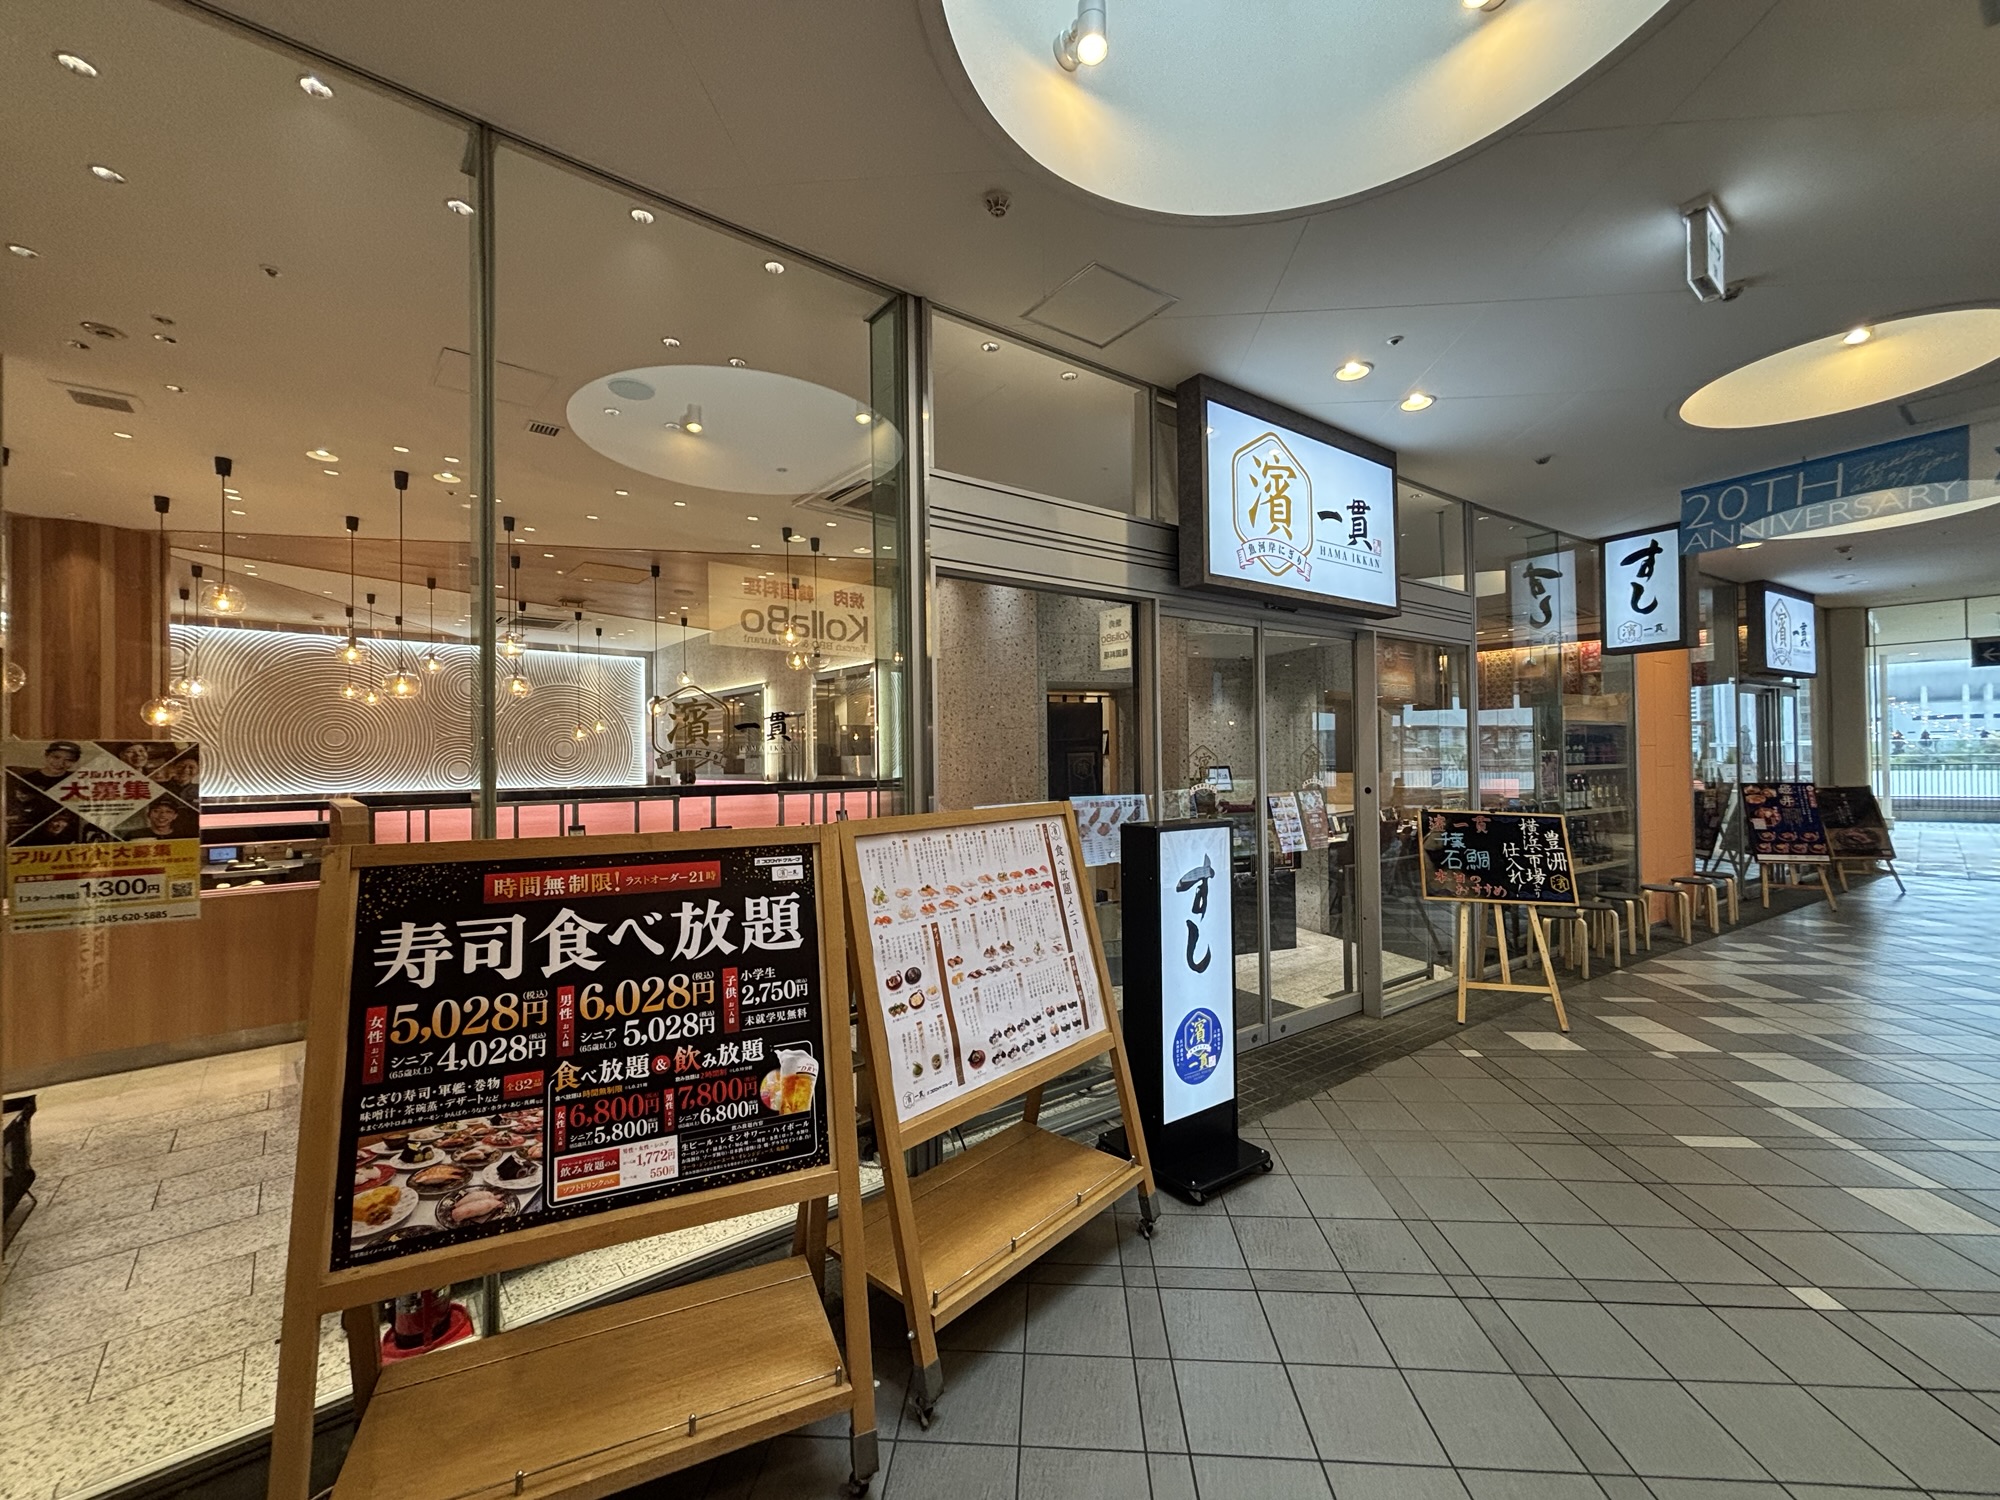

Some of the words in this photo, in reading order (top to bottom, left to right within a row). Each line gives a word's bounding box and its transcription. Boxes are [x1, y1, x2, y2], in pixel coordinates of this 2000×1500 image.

[1248, 454, 1297, 541] 濱
[1686, 462, 1844, 530] 20TH
[1683, 479, 1961, 553] ANNIVERSARY
[1248, 541, 1302, 566] 魚河岸にぎり
[1320, 545, 1348, 562] HAMA
[1352, 553, 1380, 569] IKKAN
[1619, 538, 1664, 615] すし
[666, 697, 716, 746] 濱
[77, 770, 135, 779] アルバイト
[60, 780, 152, 801] 大募集
[10, 844, 172, 865] アルバイト大募集
[1544, 830, 1568, 872] 豊洲
[80, 878, 160, 899] 1,300円
[1055, 844, 1079, 940] 食べ放題メニュー
[1455, 883, 1507, 898] おすすめ
[1176, 853, 1215, 974] すし
[373, 893, 804, 988] 寿司食べ放題
[725, 975, 737, 999] 子供
[740, 967, 776, 982] 小学生
[580, 973, 715, 1021] 6,028円
[741, 980, 809, 1006] 2,750円
[390, 992, 548, 1044] 5,028円
[560, 994, 573, 1020] 男性
[367, 1016, 383, 1045] 女性
[580, 1028, 617, 1043] シニア
[623, 1013, 716, 1047] 5,028円
[390, 1052, 434, 1068] シニア
[437, 1034, 547, 1072] 4,028円
[664, 1091, 674, 1110] 男性
[678, 1077, 758, 1111] 7,800円
[556, 1110, 566, 1128] 女性
[569, 1093, 660, 1128] 6,800円
[678, 1112, 699, 1124] シニア
[699, 1101, 759, 1126] 6,800円
[570, 1131, 593, 1142] シニア
[593, 1119, 659, 1145] 5,800円
[560, 1160, 618, 1178] 飲み放題のみ
[636, 1149, 676, 1168] 1,772円
[650, 1166, 676, 1180] 550円
